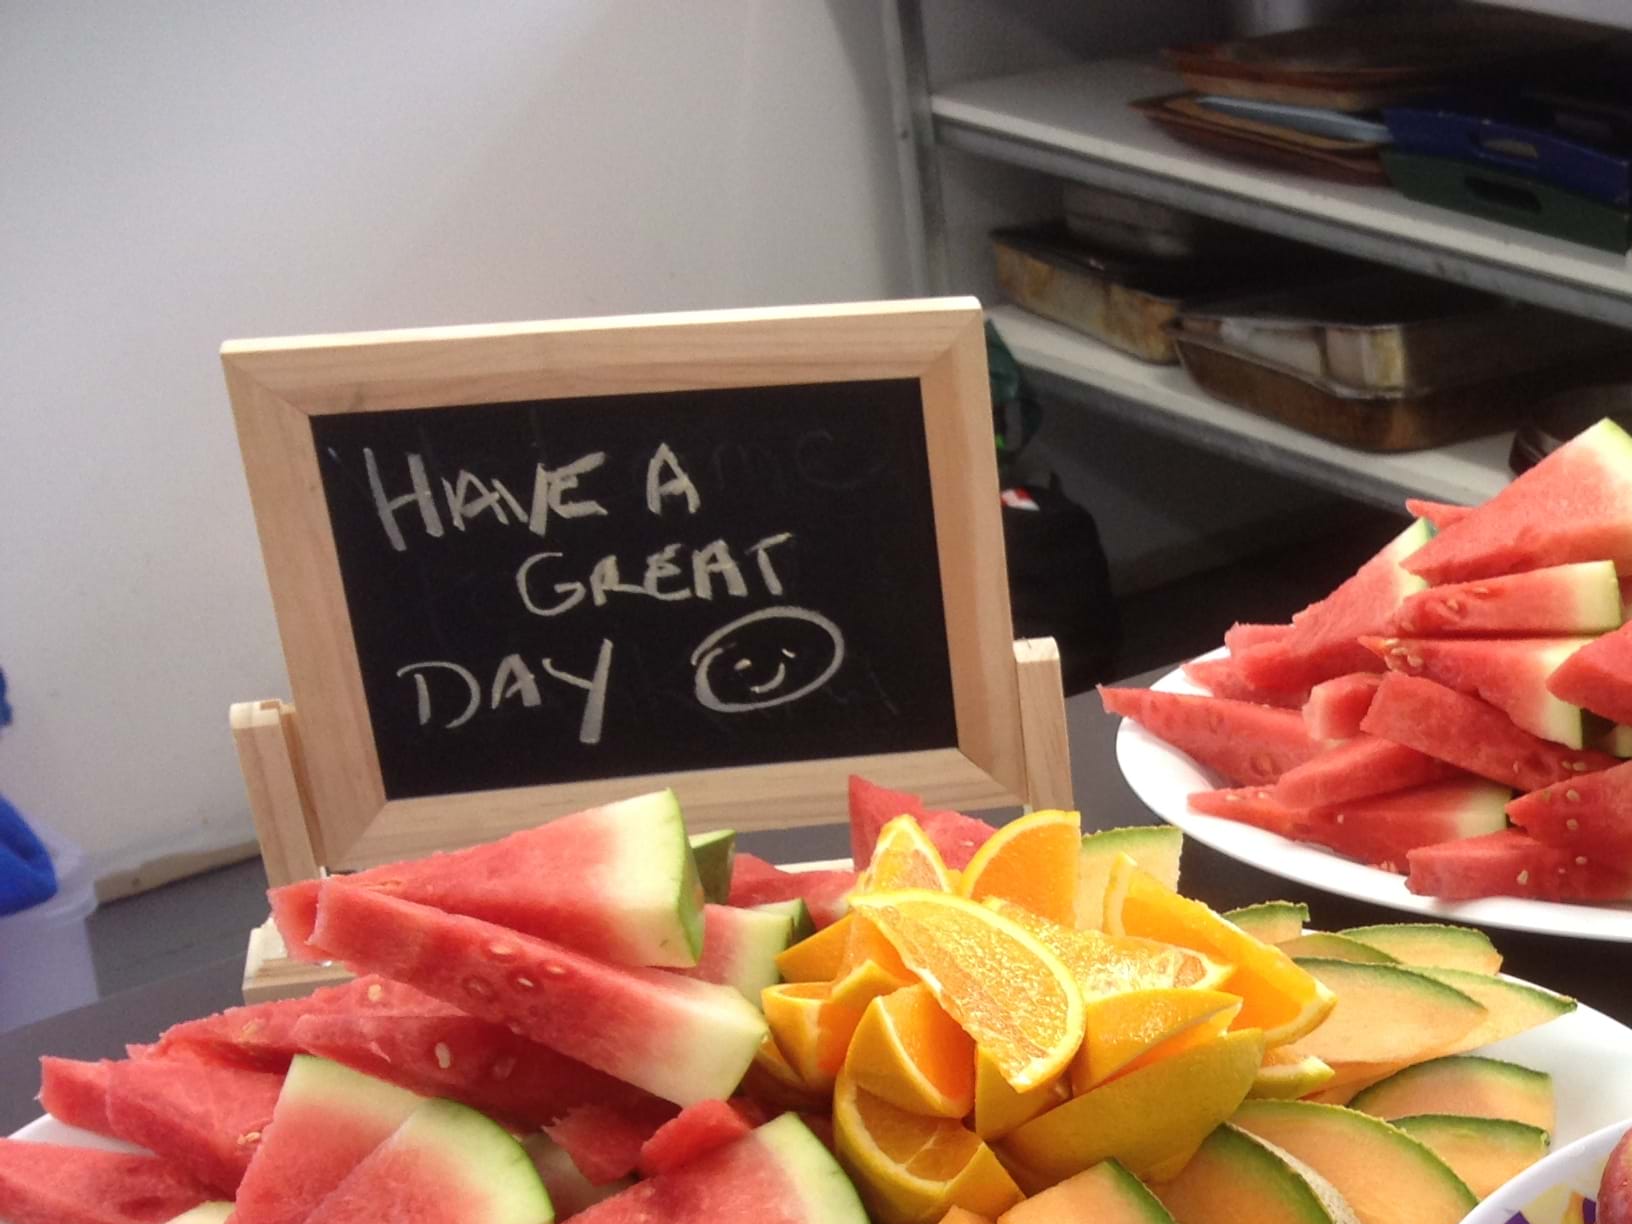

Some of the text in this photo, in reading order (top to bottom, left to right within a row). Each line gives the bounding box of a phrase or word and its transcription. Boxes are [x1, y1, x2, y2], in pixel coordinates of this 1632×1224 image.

[362, 447, 608, 552] HAVE
[645, 441, 701, 516] A
[516, 532, 795, 617] GREAT
[396, 638, 614, 745] DAY
